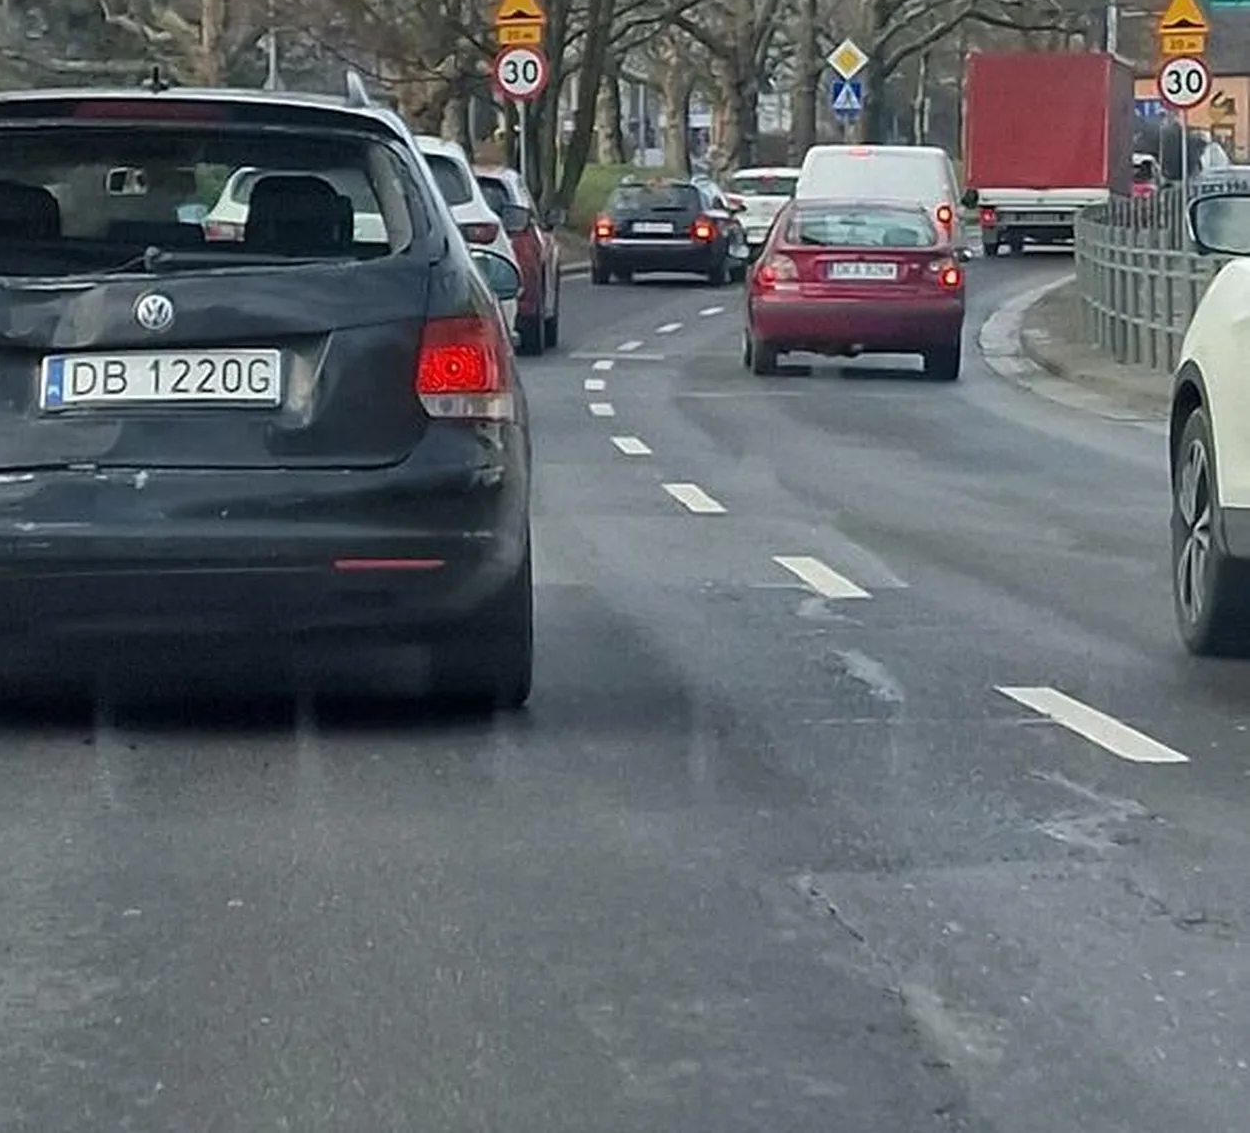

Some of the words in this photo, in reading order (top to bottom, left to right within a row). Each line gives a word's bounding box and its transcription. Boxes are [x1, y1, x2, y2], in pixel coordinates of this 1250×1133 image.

[504, 60, 538, 84] 30
[1167, 69, 1203, 95] 30
[72, 360, 128, 395] DB
[148, 358, 270, 394] 1220G
